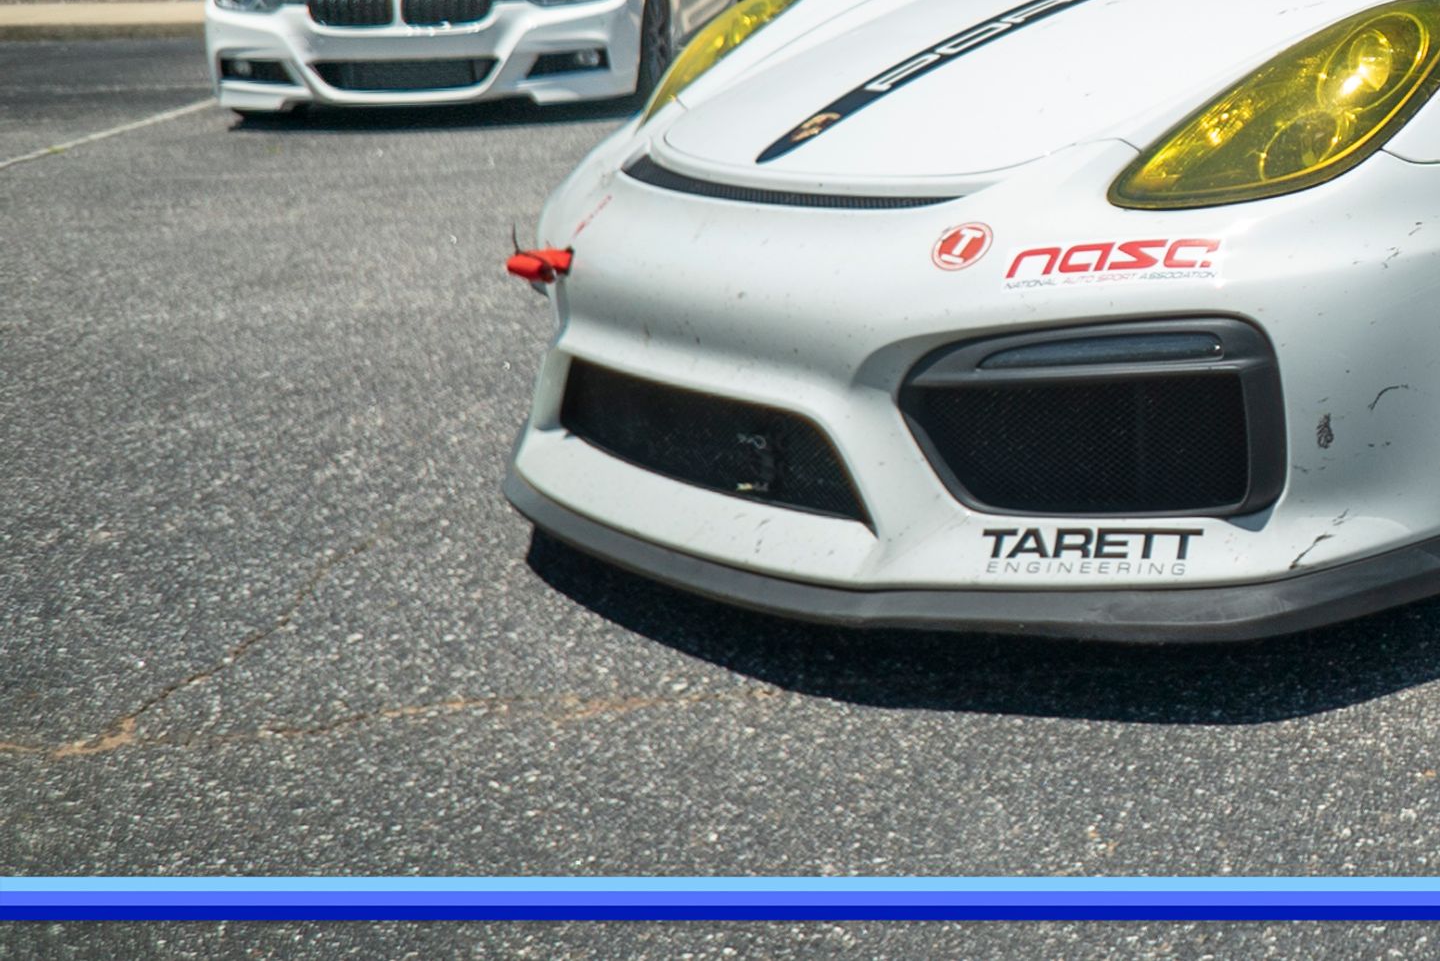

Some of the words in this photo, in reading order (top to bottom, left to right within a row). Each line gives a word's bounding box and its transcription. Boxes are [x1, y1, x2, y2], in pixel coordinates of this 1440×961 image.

[1004, 279, 1056, 289] NATIONAL
[1064, 276, 1094, 285] AUTO
[1096, 273, 1136, 283] SPORT
[1139, 271, 1218, 281] ASSOCIATION
[983, 527, 1204, 560] TARETT
[986, 561, 1186, 576] ENGINEERING
